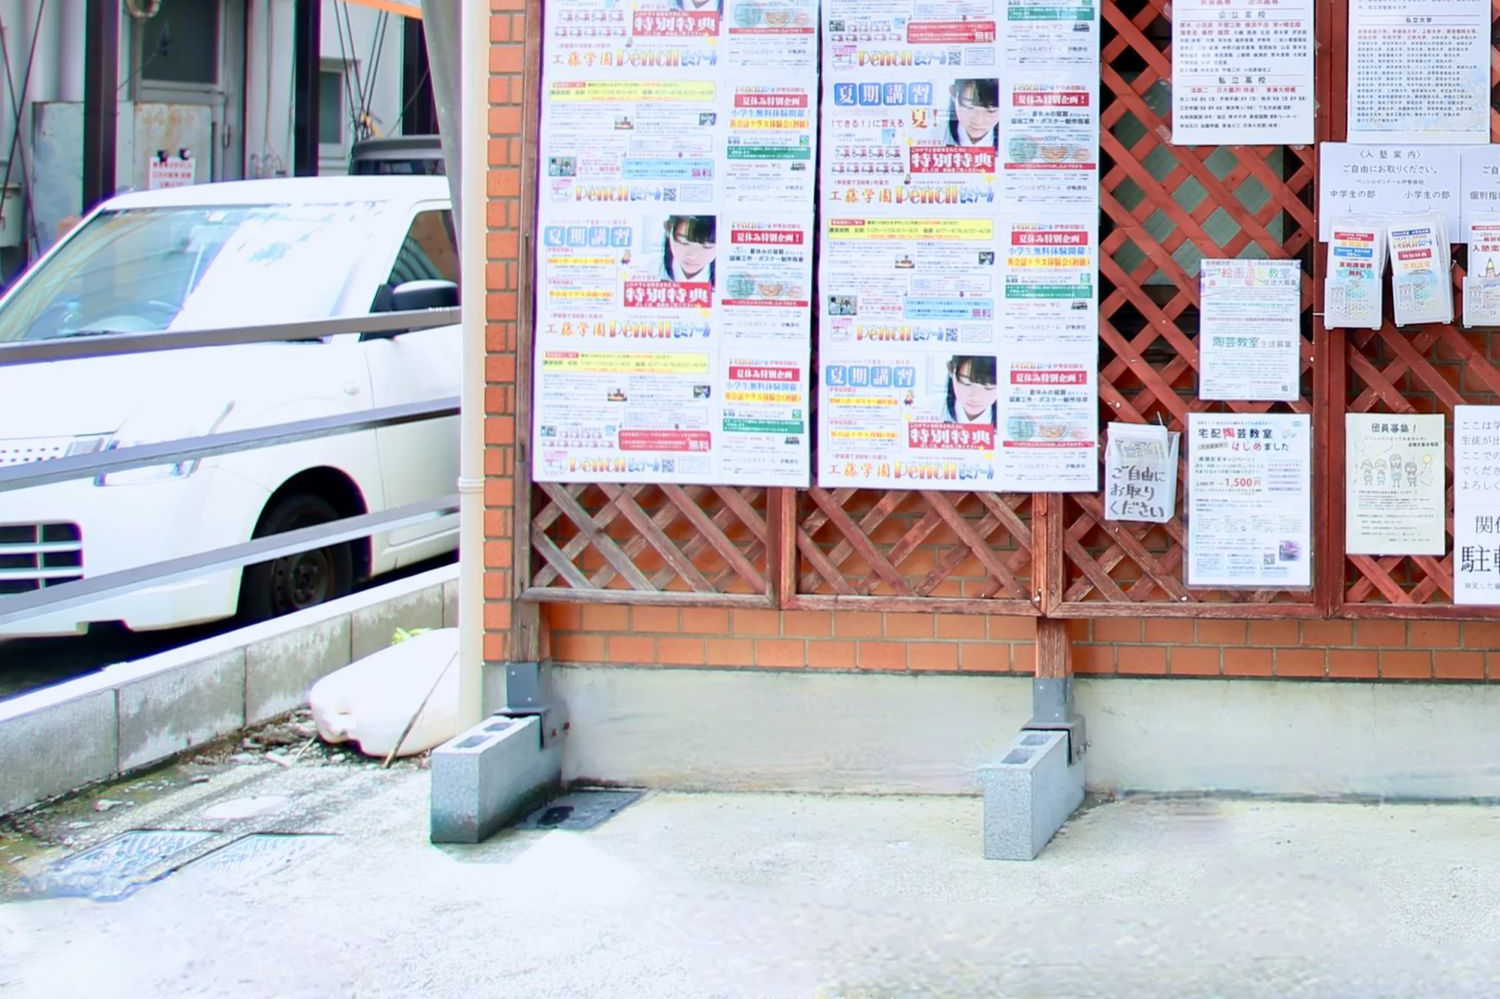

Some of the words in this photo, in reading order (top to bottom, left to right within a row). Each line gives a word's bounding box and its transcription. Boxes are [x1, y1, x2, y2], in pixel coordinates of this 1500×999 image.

[634, 17, 717, 32] 特別特典
[1218, 76, 1266, 84] 私立高校
[838, 84, 931, 105] 夏期講習
[911, 152, 993, 167] 特別特典
[1343, 164, 1439, 175] ご自由にお取りください。
[1330, 190, 1376, 199] 中学生の部
[1404, 190, 1451, 200] 小学生の部
[625, 287, 709, 303] 特別特典
[829, 366, 913, 386] 夏期講習
[910, 429, 991, 445] 特別特典
[1198, 428, 1272, 439] 宅配陶芸教室
[1232, 441, 1289, 451] はじめました
[1111, 465, 1166, 483] ご自由に
[1110, 483, 1155, 501] お取り
[1109, 501, 1165, 518] ください
